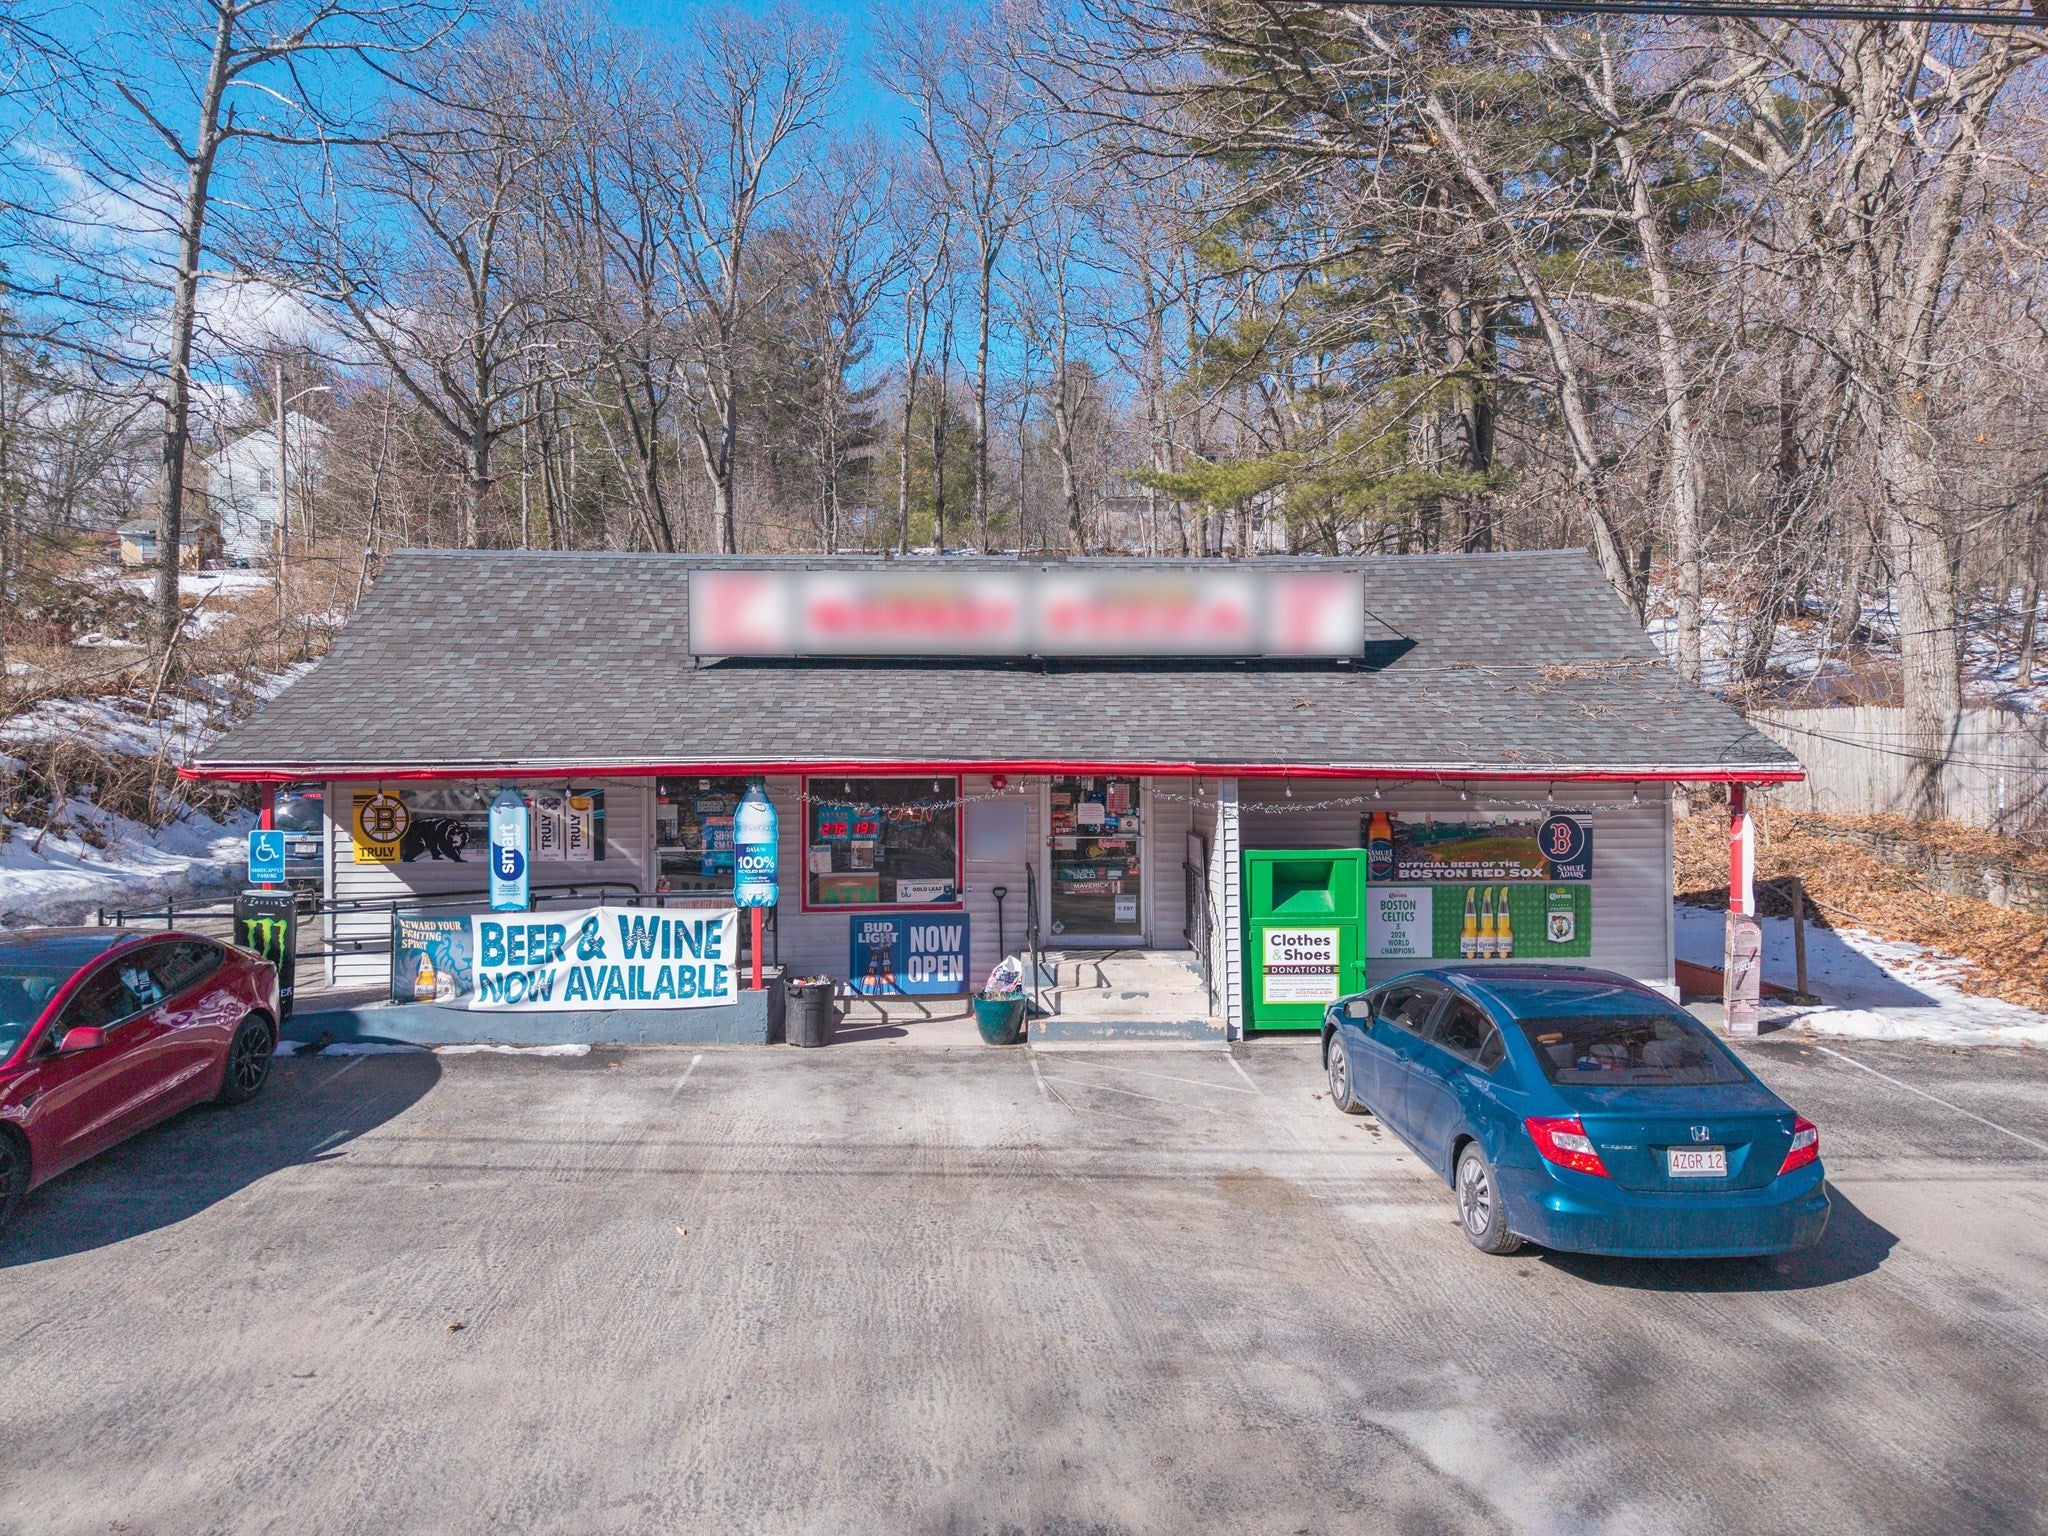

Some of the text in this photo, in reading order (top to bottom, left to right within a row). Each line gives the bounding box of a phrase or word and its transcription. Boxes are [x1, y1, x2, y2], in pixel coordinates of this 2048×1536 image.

[886, 805, 934, 822] OPEN
[541, 814, 552, 850] TRULY
[570, 814, 580, 850] TRULY
[821, 822, 877, 834] 272 197
[1550, 823, 1571, 854] B
[359, 847, 396, 858] TRULY
[500, 823, 515, 874] smart
[737, 855, 775, 869] 100%
[1368, 855, 1392, 863] ADAMS
[1399, 867, 1543, 878] BOSTON RED SOX
[1557, 863, 1586, 872] SAMUEL
[1560, 871, 1585, 879] ADAMS
[823, 887, 878, 904] ATM
[1380, 900, 1416, 910] BOSTON
[1382, 911, 1415, 922] CELTICS
[437, 921, 462, 931] YOUR
[863, 922, 893, 933] BUD
[480, 914, 724, 968] BEER & WINE
[857, 933, 899, 943] LIGHT
[910, 925, 963, 953] NOW
[1270, 934, 1331, 946] Clothes
[1272, 948, 1331, 961] & Shoes
[908, 954, 964, 983] OPEN
[1271, 966, 1331, 974] DONATIONS
[478, 963, 729, 1005] NOW AVAILABLE
[1672, 1153, 1723, 1169] 4ZGR 12
